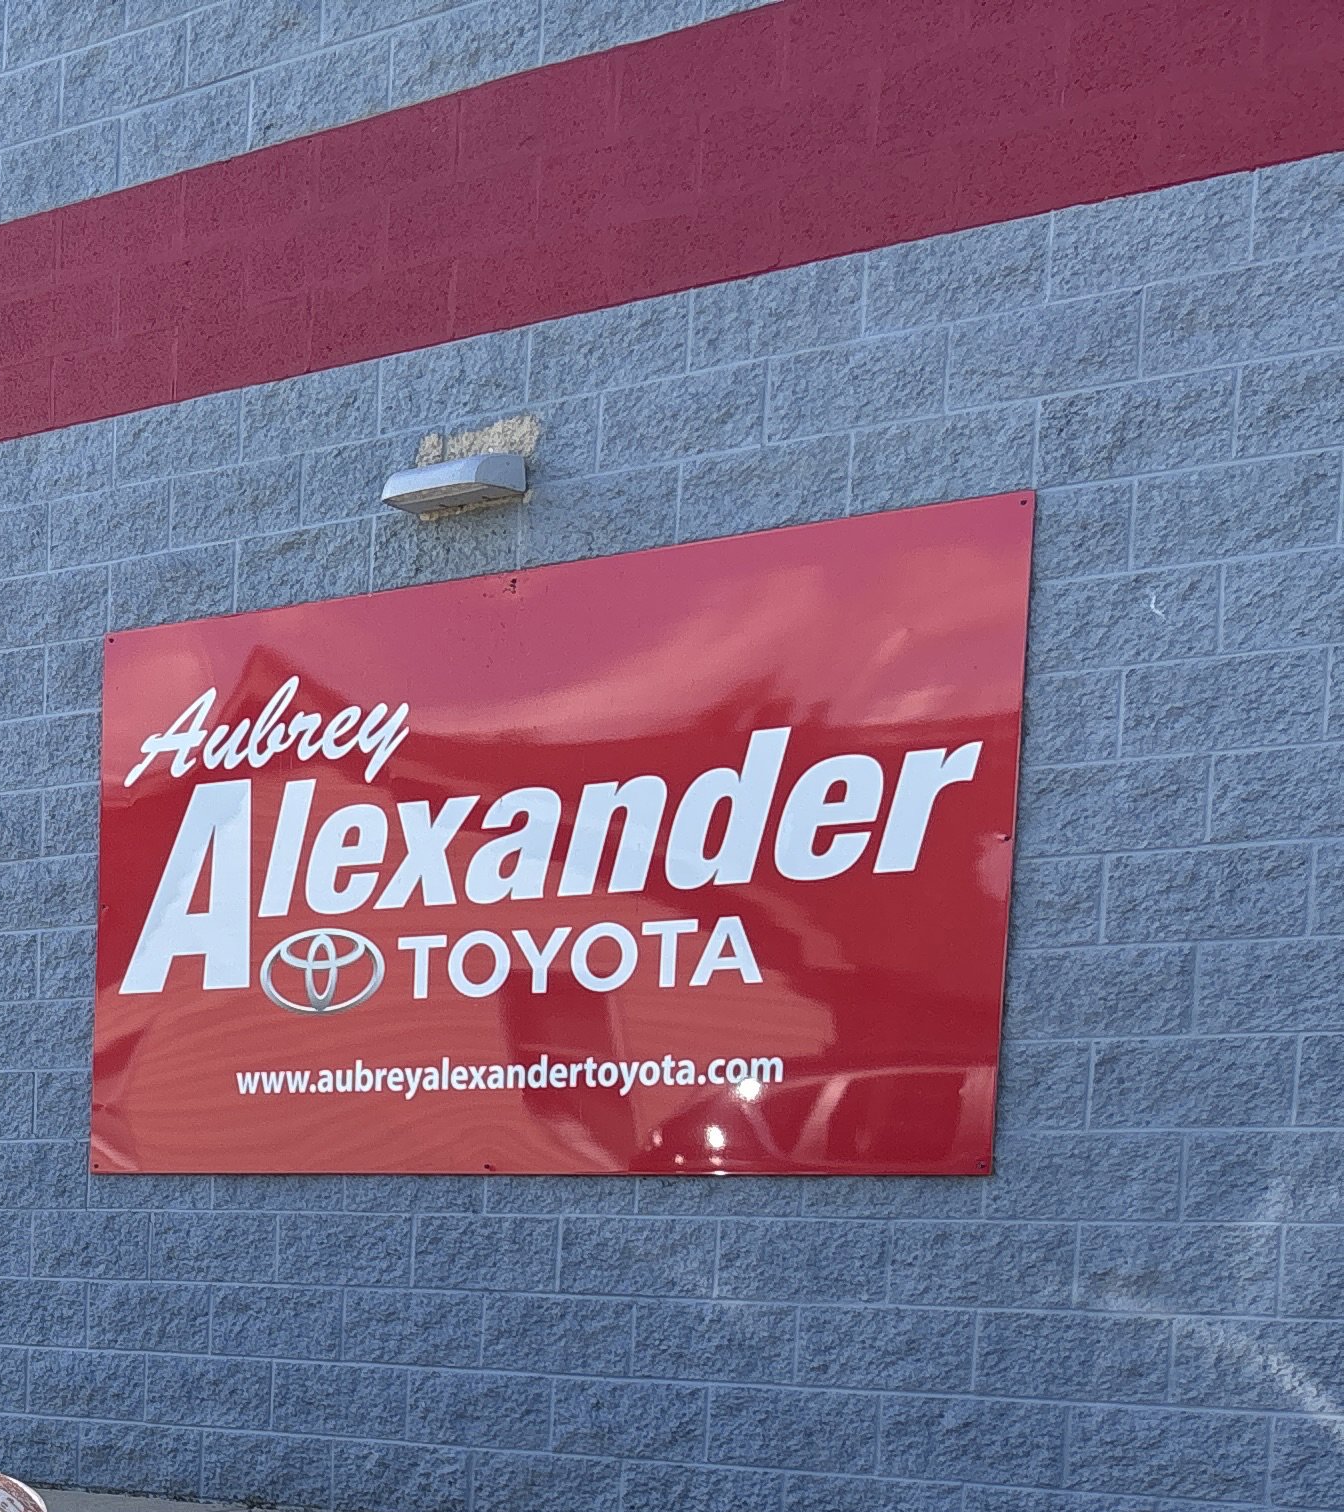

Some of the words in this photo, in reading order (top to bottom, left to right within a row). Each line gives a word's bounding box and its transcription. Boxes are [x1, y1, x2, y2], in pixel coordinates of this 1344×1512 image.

[124, 675, 410, 787] Aubrey
[119, 727, 983, 995] Alexander
[398, 916, 764, 1000] TOYOTA
[236, 1055, 784, 1100] www.aubreyalexandertoyota.com
